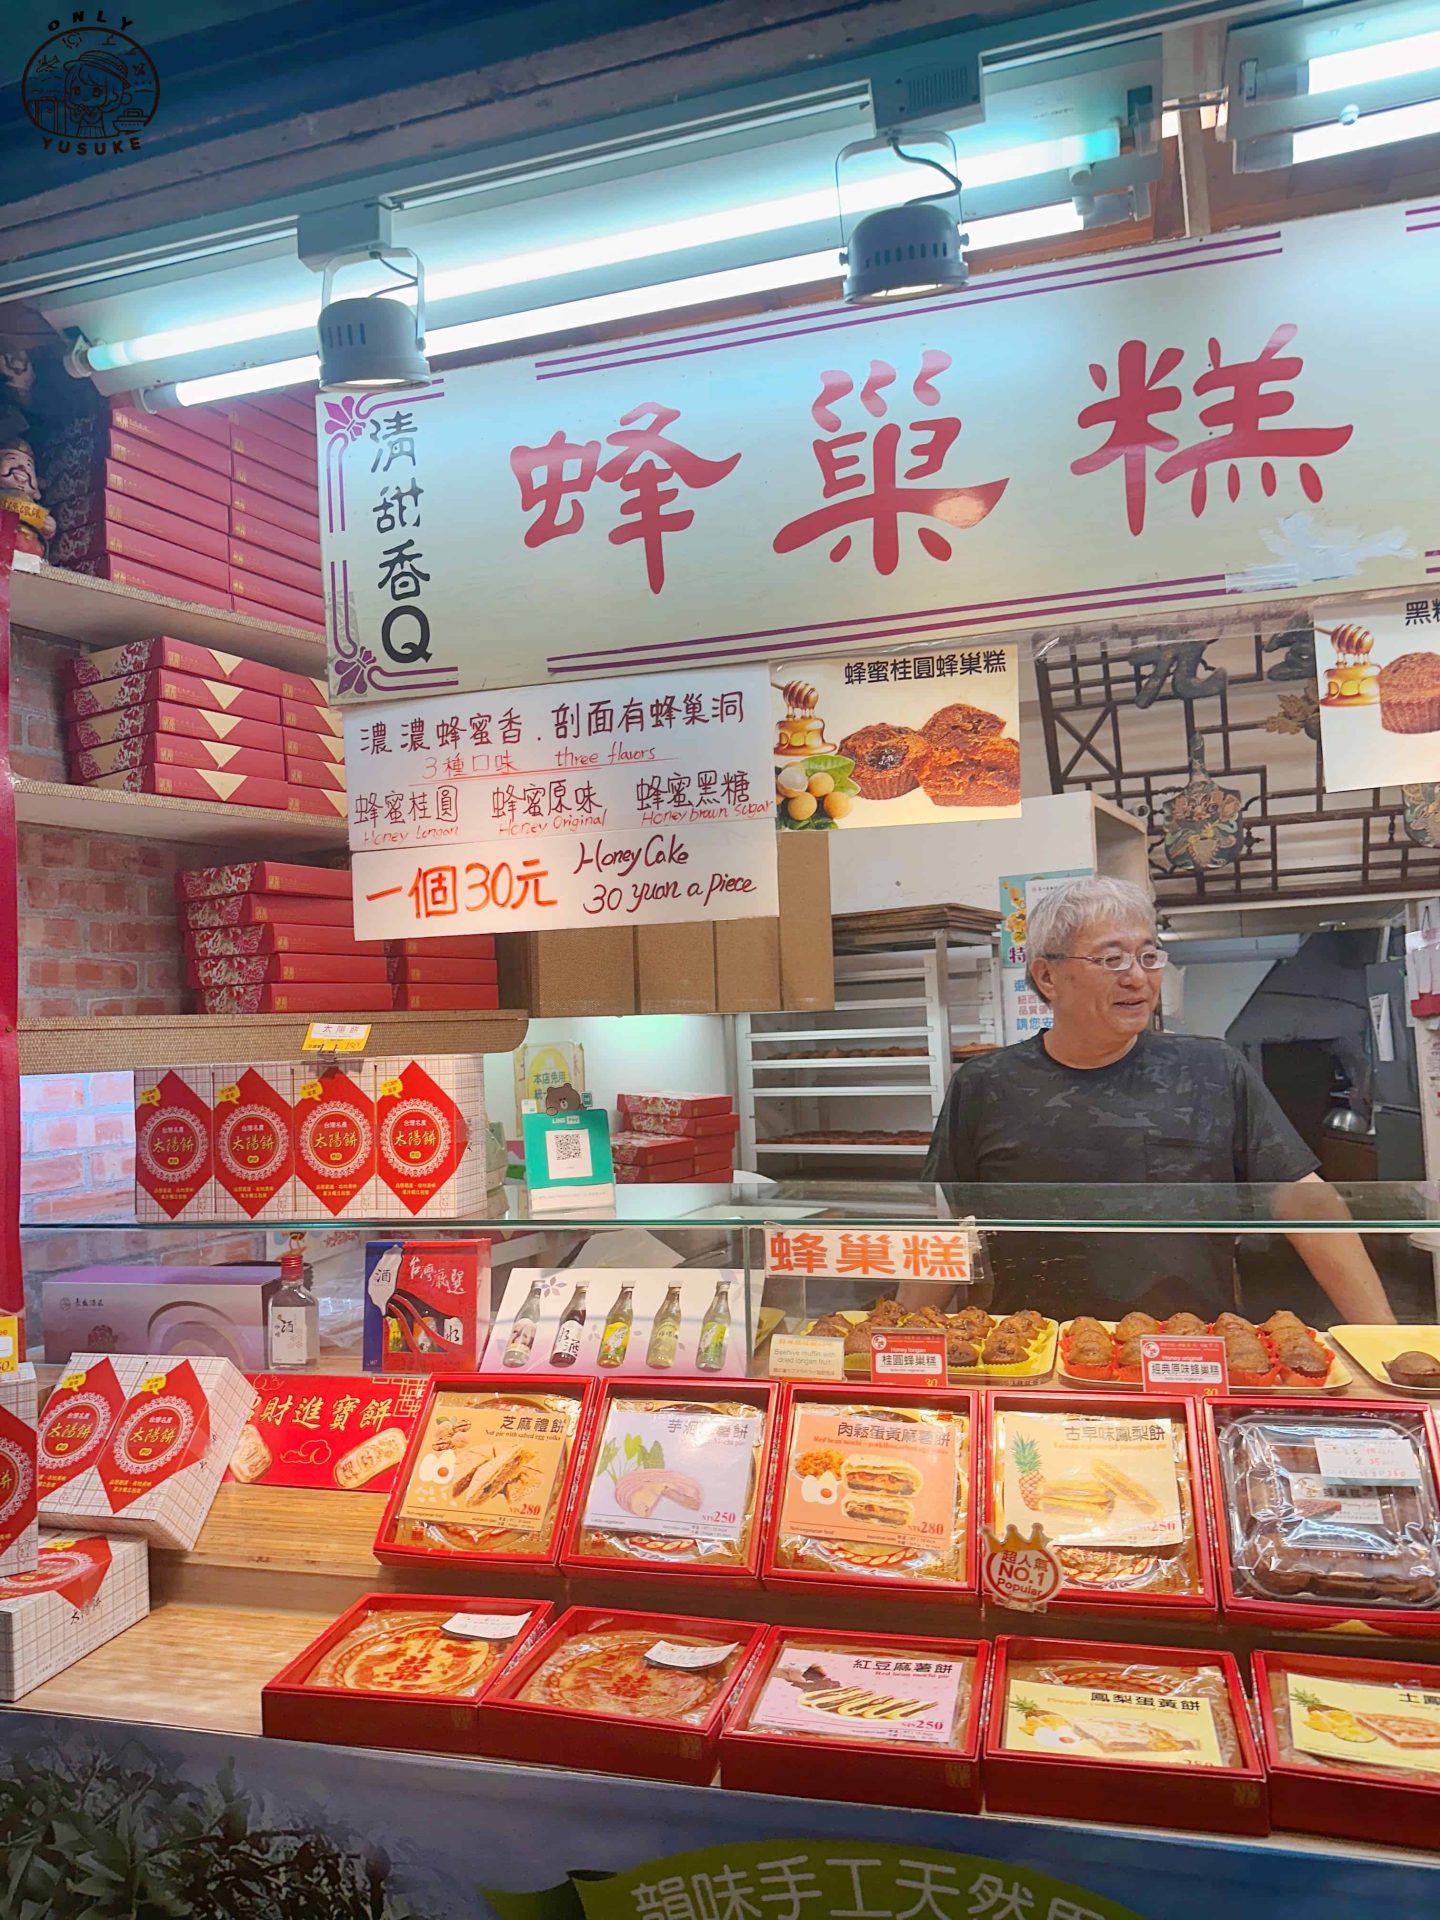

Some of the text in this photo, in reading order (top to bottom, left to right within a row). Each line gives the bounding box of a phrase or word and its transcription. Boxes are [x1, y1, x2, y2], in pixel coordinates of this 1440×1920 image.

[510, 323, 1354, 595] 蜂巢糕
[844, 649, 1007, 686] 蜂蜜桂圓蜂巢糕
[555, 746, 599, 767] three
[636, 769, 751, 811] 蜂蜜黑糖
[354, 784, 459, 829] 蜂蜜桂圓
[492, 778, 603, 823] 蜂蜜原味
[573, 833, 690, 877] Honey Cake
[583, 886, 623, 914] 30
[686, 882, 702, 897] a
[152, 1137, 195, 1153] 太陽餅
[231, 1136, 275, 1152] 太陽餅
[313, 1133, 358, 1149] 太陽餅
[393, 1130, 437, 1147] 太陽餅
[769, 1231, 968, 1278] 蜂巢糕
[375, 1269, 392, 1283] 酒
[881, 1354, 937, 1367] 桂圓蜂巢糕
[924, 1378, 938, 1388] 30
[1203, 1387, 1219, 1397] 30
[47, 1421, 93, 1438] 太陽餅
[500, 1414, 567, 1435] 芝麻禮餅
[1064, 1424, 1166, 1443] 古早味鳳梨餅
[129, 1426, 177, 1444] 太陽餅
[1001, 1549, 1049, 1574] 超人氣
[997, 1577, 1043, 1597] Popular
[852, 1658, 953, 1675] 紅豆麻薯餅
[1090, 1692, 1201, 1712] 鳳梨蛋黃餅
